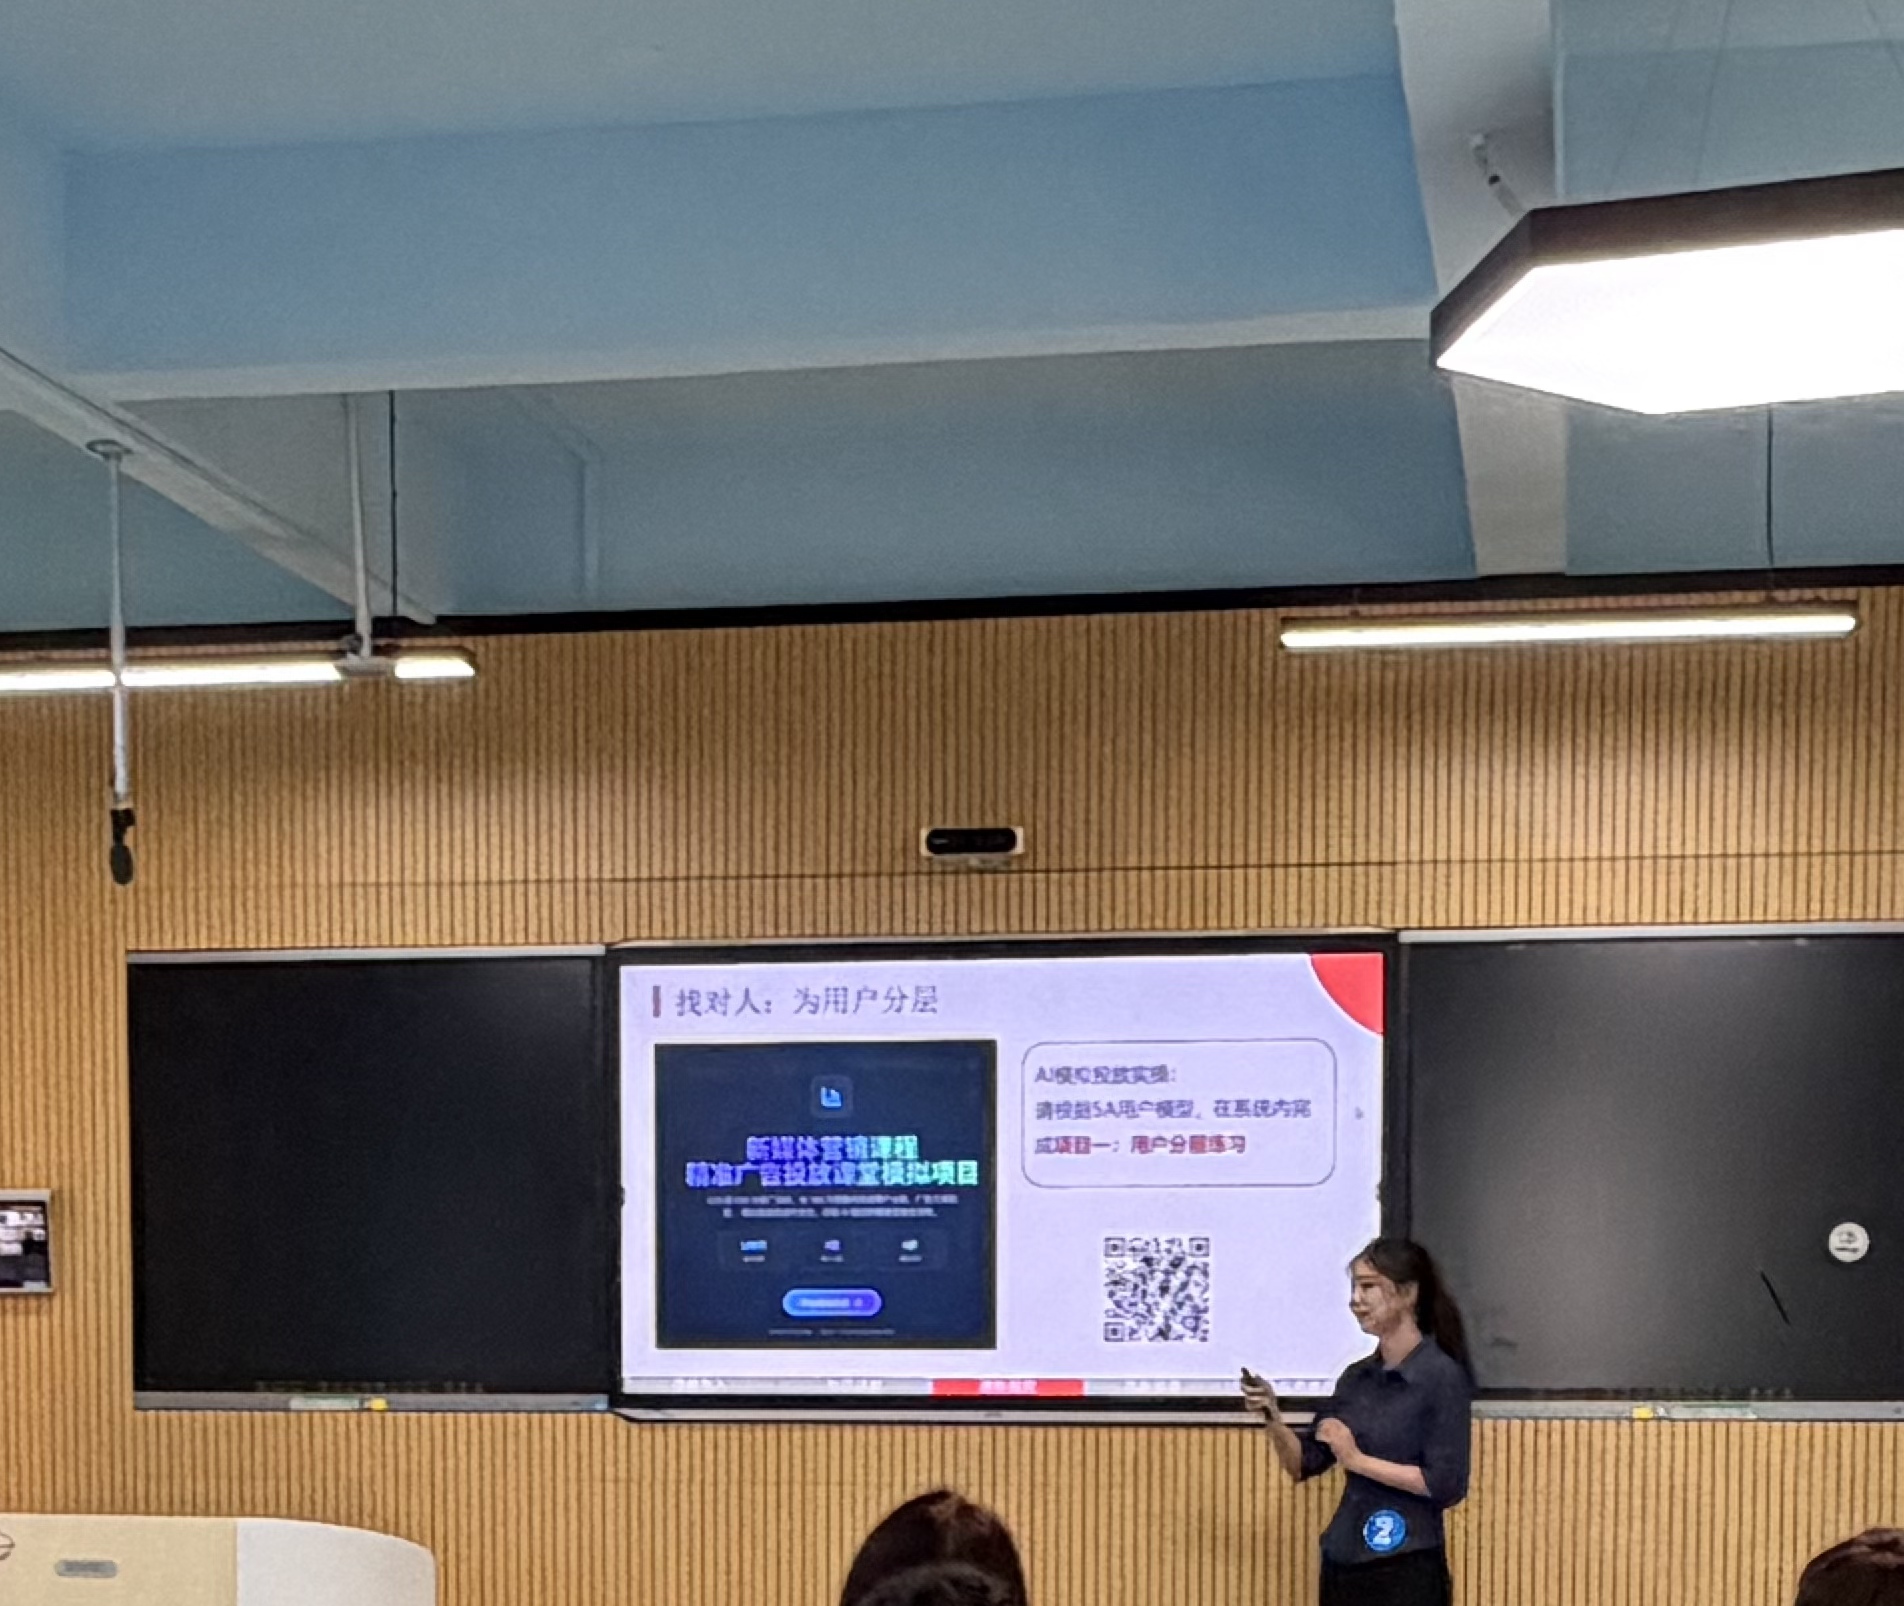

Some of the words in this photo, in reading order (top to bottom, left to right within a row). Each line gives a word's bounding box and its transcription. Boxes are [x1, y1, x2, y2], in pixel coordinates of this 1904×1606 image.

[675, 985, 938, 1017] 找对人：为用户分层
[1372, 1516, 1394, 1545] 2
